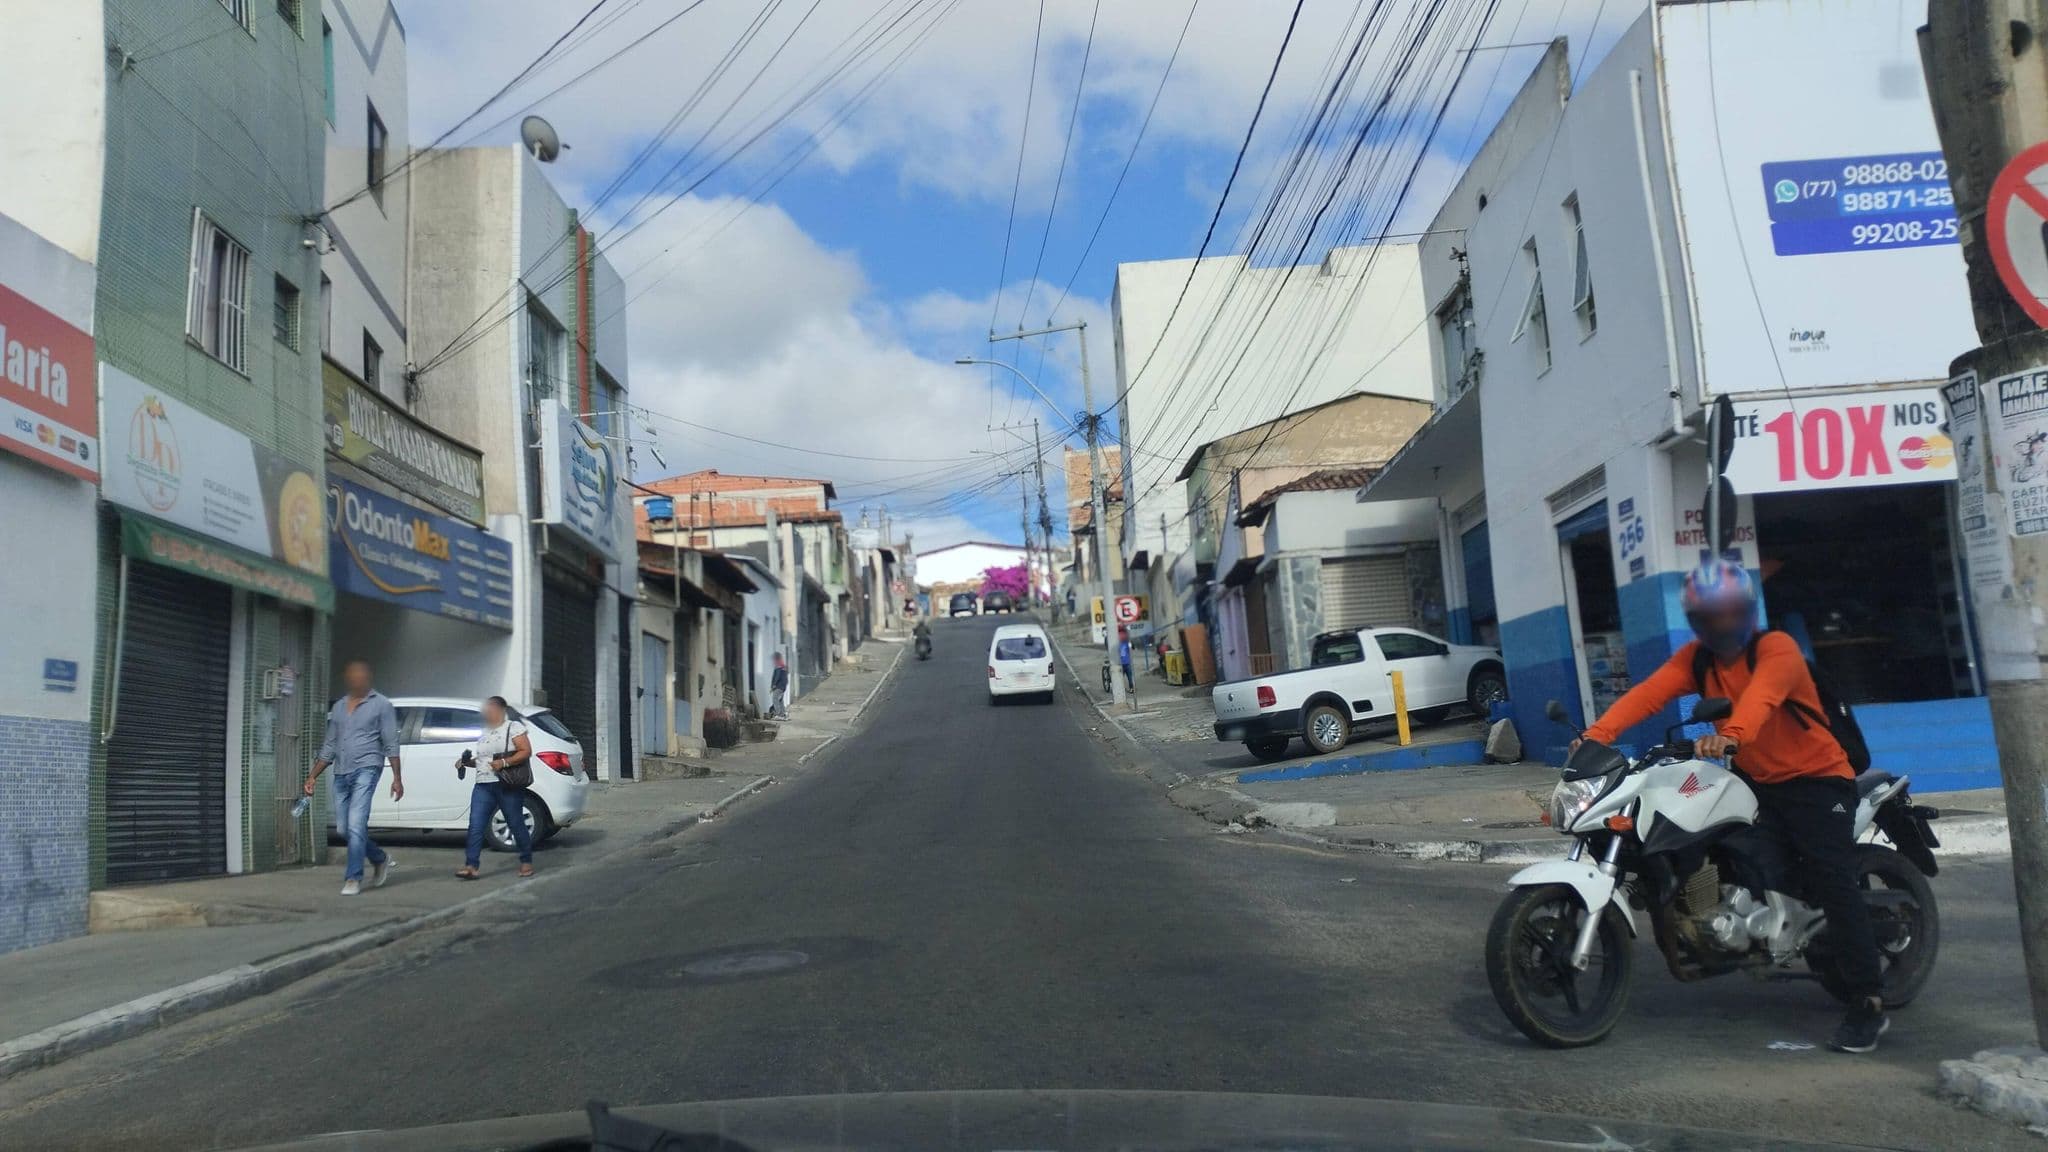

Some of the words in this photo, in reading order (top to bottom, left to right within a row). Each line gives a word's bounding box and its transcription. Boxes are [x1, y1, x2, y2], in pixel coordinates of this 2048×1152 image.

[1803, 180, 1837, 199] (77)
[1852, 217, 1961, 245] 99208-25
[2002, 374, 2048, 399] MÃE
[1731, 408, 1760, 438] TÉ
[1764, 404, 1893, 482] 10X
[1893, 401, 1937, 426] NOS
[1618, 516, 1645, 561] 256
[1685, 783, 1714, 798] HONDA
